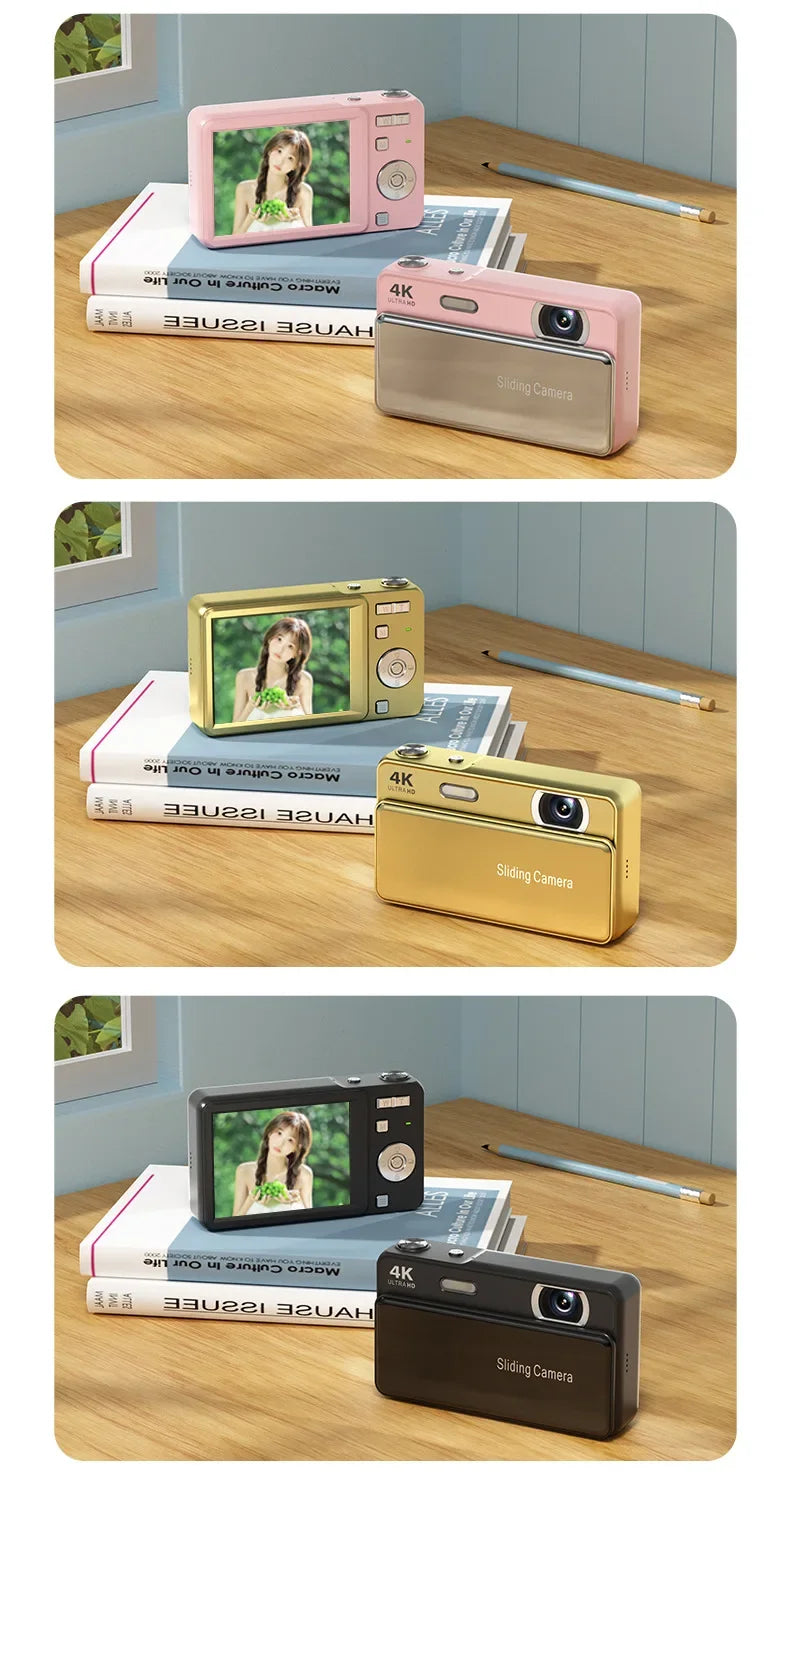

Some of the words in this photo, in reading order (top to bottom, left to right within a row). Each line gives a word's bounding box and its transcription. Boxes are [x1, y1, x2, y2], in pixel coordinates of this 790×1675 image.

[143, 276, 168, 285] Life
[173, 278, 201, 287] Our
[208, 280, 220, 288] In
[225, 280, 282, 292] Culture
[288, 283, 341, 295] Macro
[389, 283, 414, 299] 4K
[497, 375, 531, 396] Sliding
[533, 382, 573, 401] Camera
[143, 764, 168, 773] Life
[173, 766, 201, 775] Our
[208, 768, 220, 776] In
[225, 768, 282, 780] Culture
[288, 771, 341, 783] Macro
[389, 771, 414, 787] 4K
[497, 863, 531, 884] Sliding
[533, 870, 573, 889] Camera
[143, 1258, 168, 1267] Life
[173, 1260, 201, 1269] Our
[208, 1262, 220, 1270] In
[225, 1262, 282, 1274] Culture
[288, 1265, 341, 1277] Macro
[389, 1265, 414, 1281] 4K
[497, 1357, 531, 1378] Sliding
[533, 1364, 573, 1383] Camera
